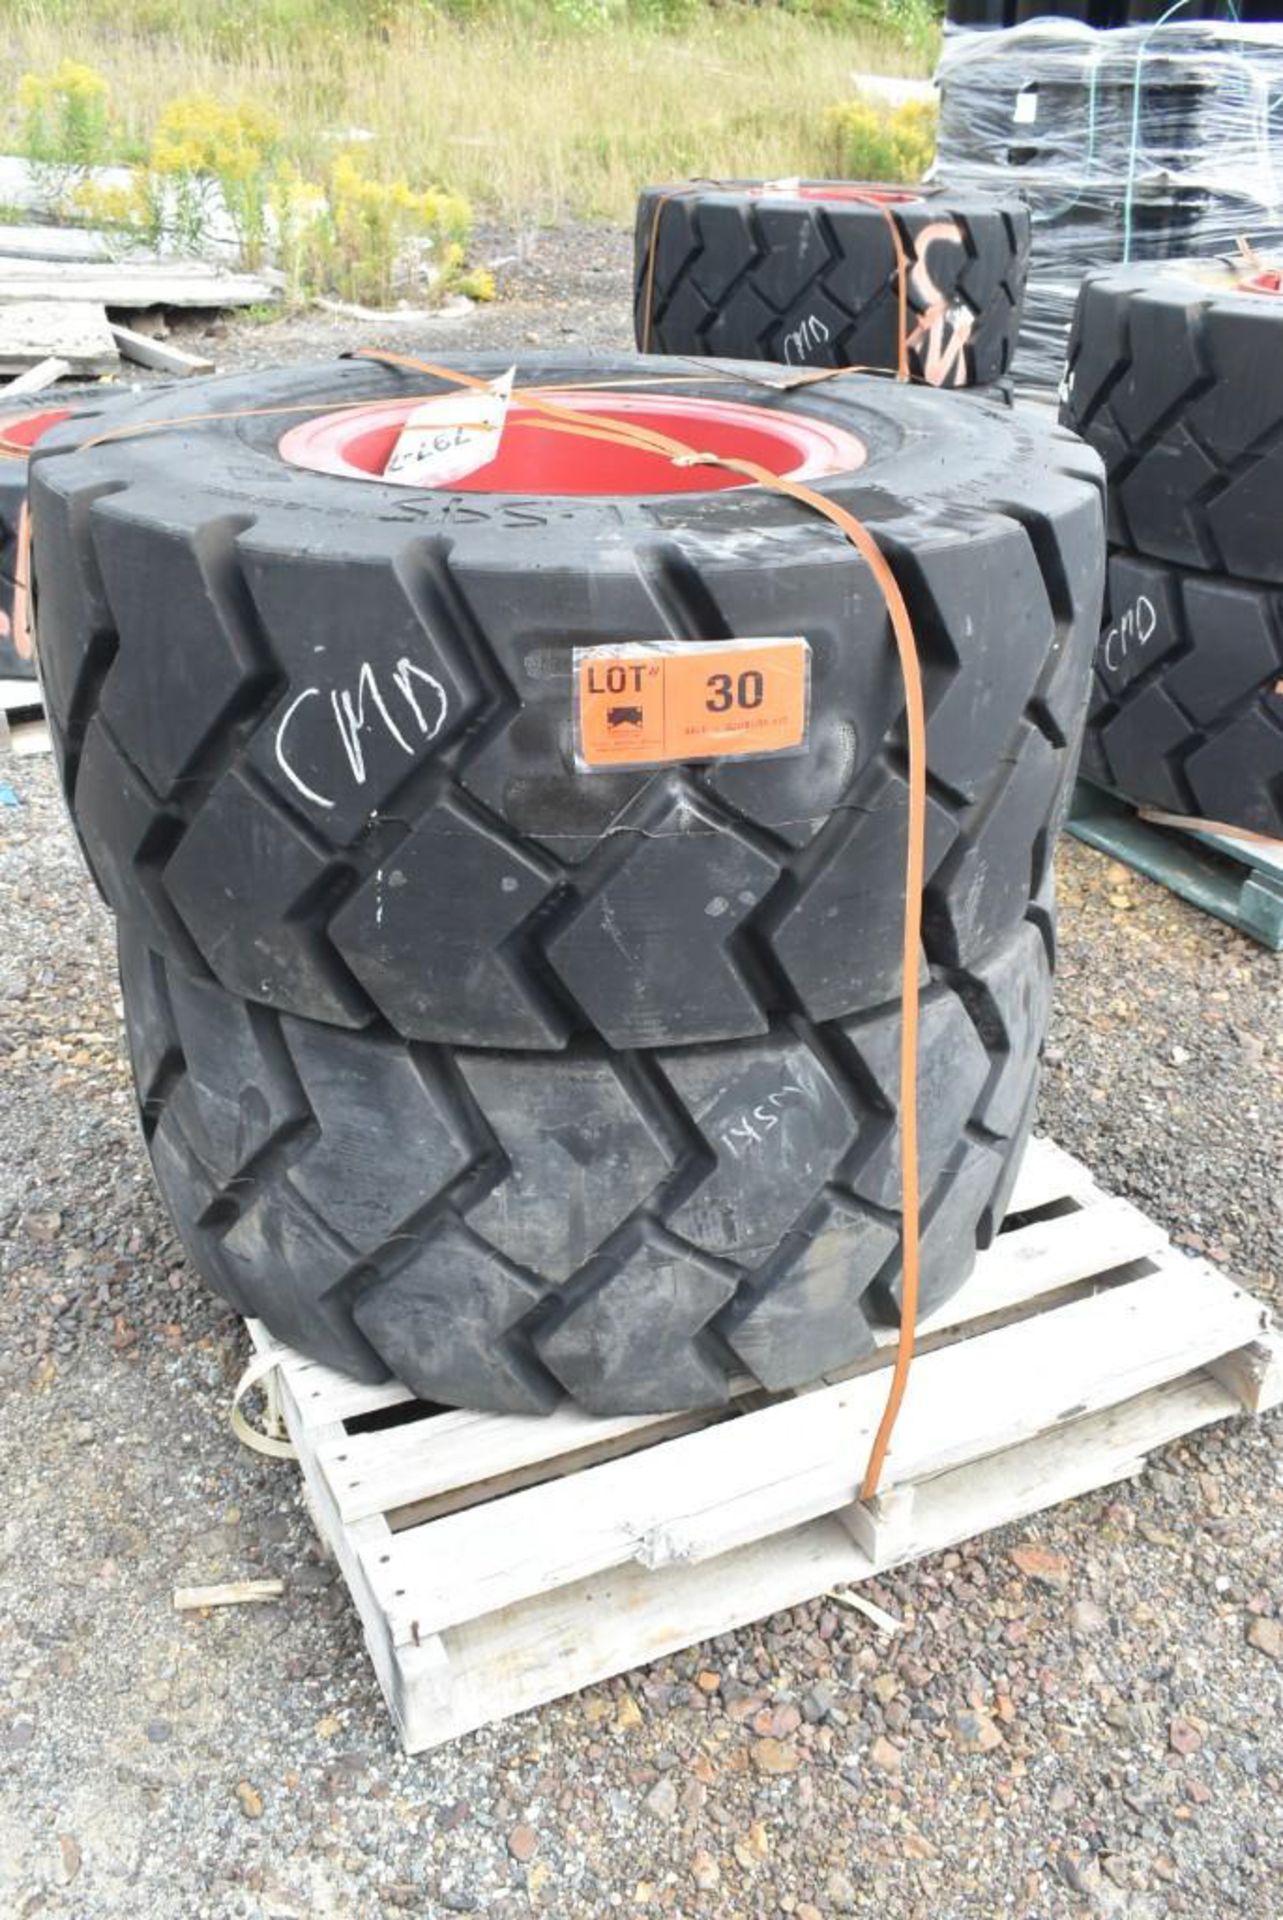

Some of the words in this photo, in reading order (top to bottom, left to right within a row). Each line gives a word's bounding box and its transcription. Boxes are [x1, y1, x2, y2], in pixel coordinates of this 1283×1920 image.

[1105, 595, 1157, 671] CMD
[705, 670, 763, 713] 30
[276, 657, 447, 809] CMD
